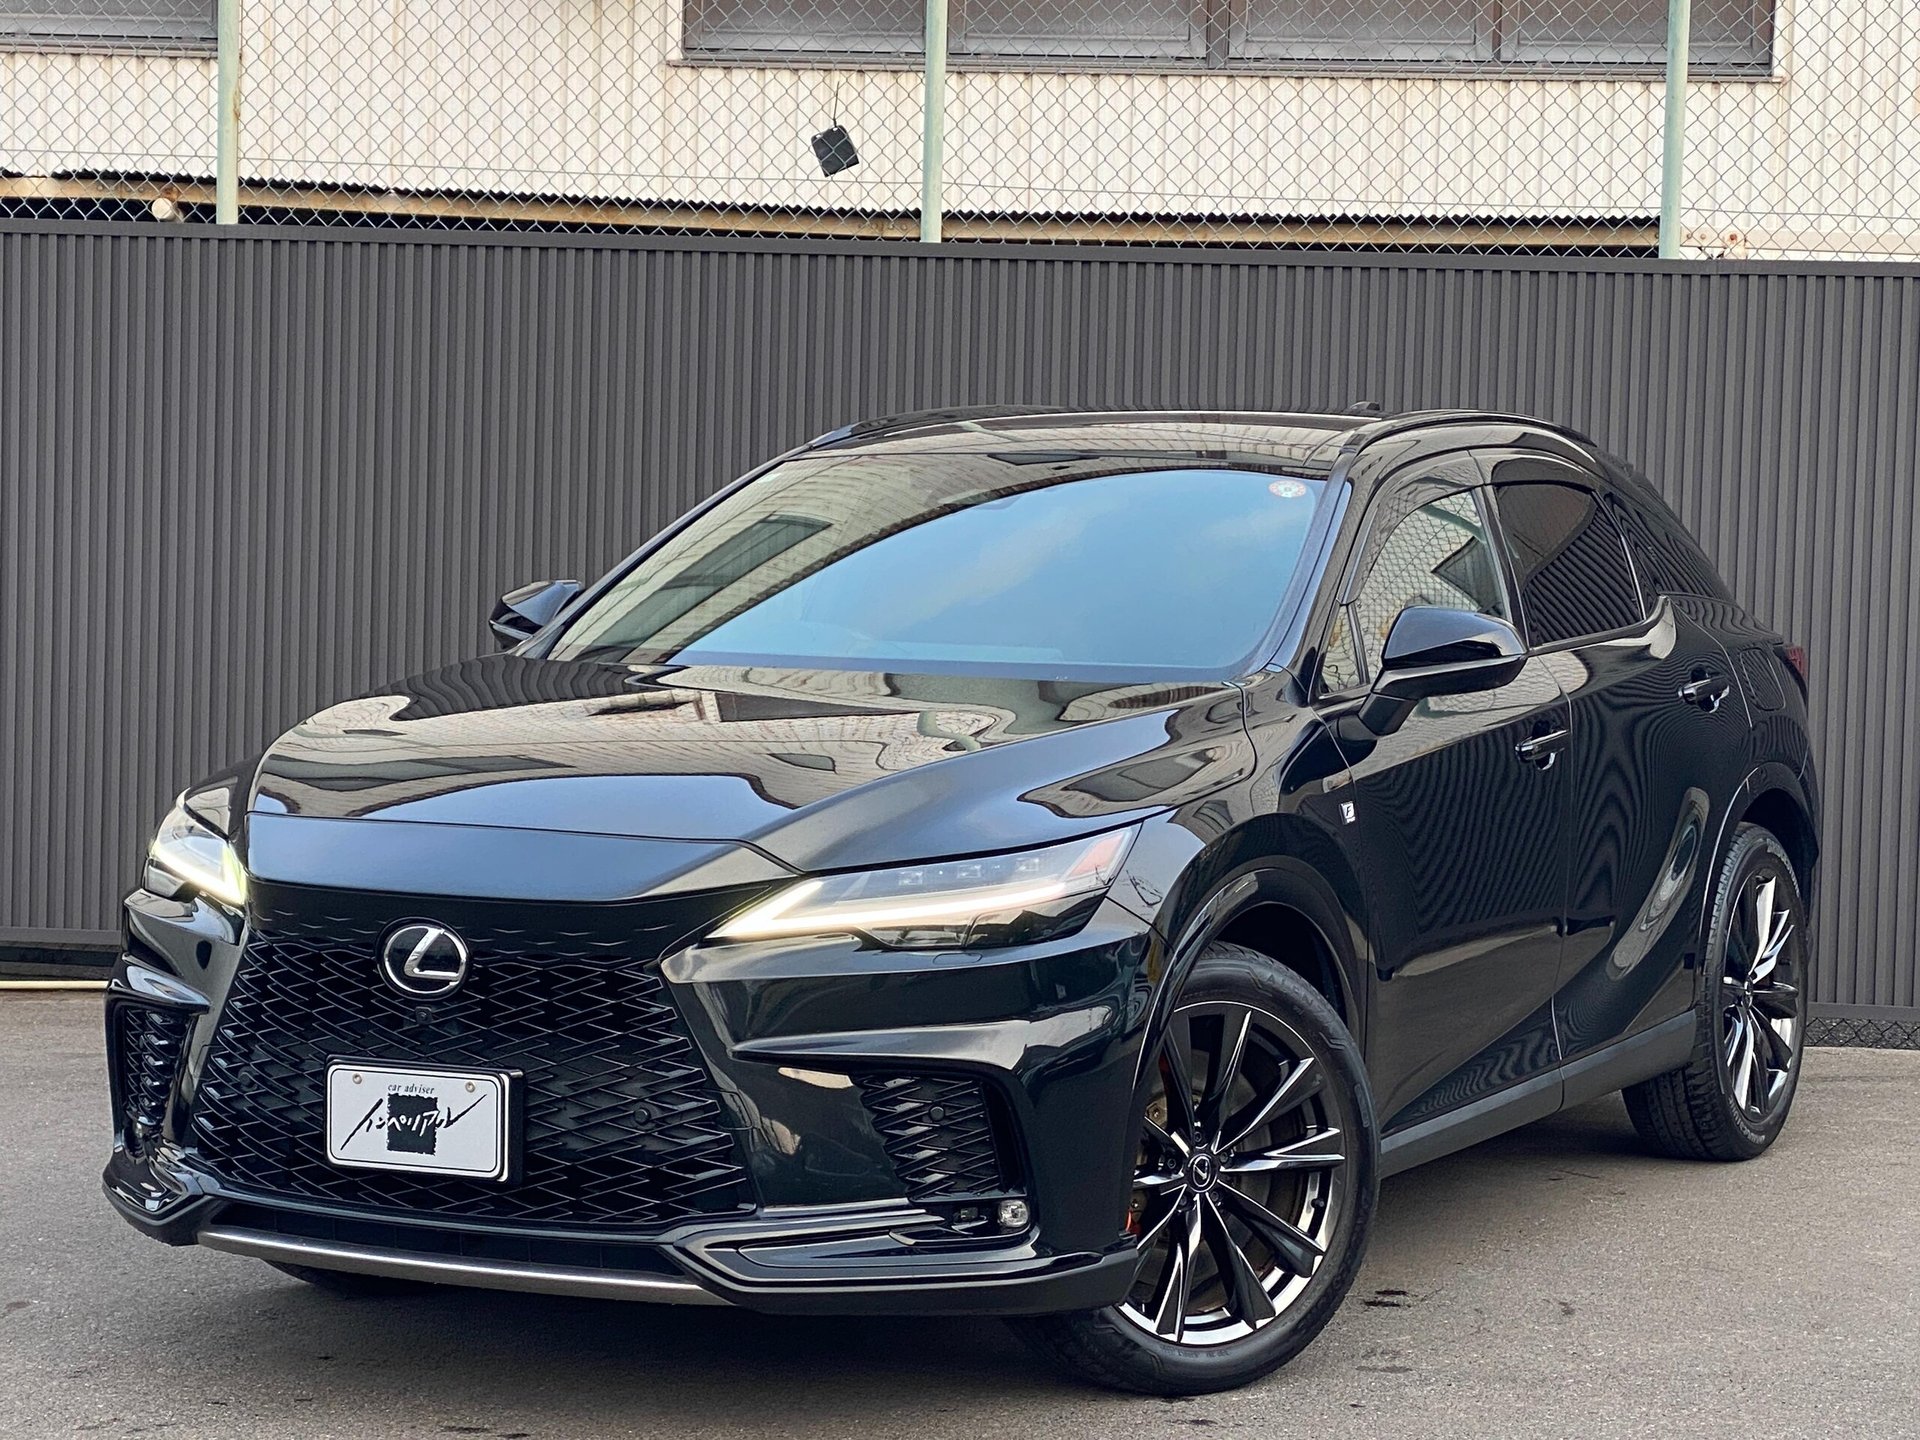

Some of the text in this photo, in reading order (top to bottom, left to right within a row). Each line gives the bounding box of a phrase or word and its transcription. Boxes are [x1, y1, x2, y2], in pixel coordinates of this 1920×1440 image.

[387, 1083, 435, 1095] car adviser
[341, 1094, 487, 1150] インペリアル
